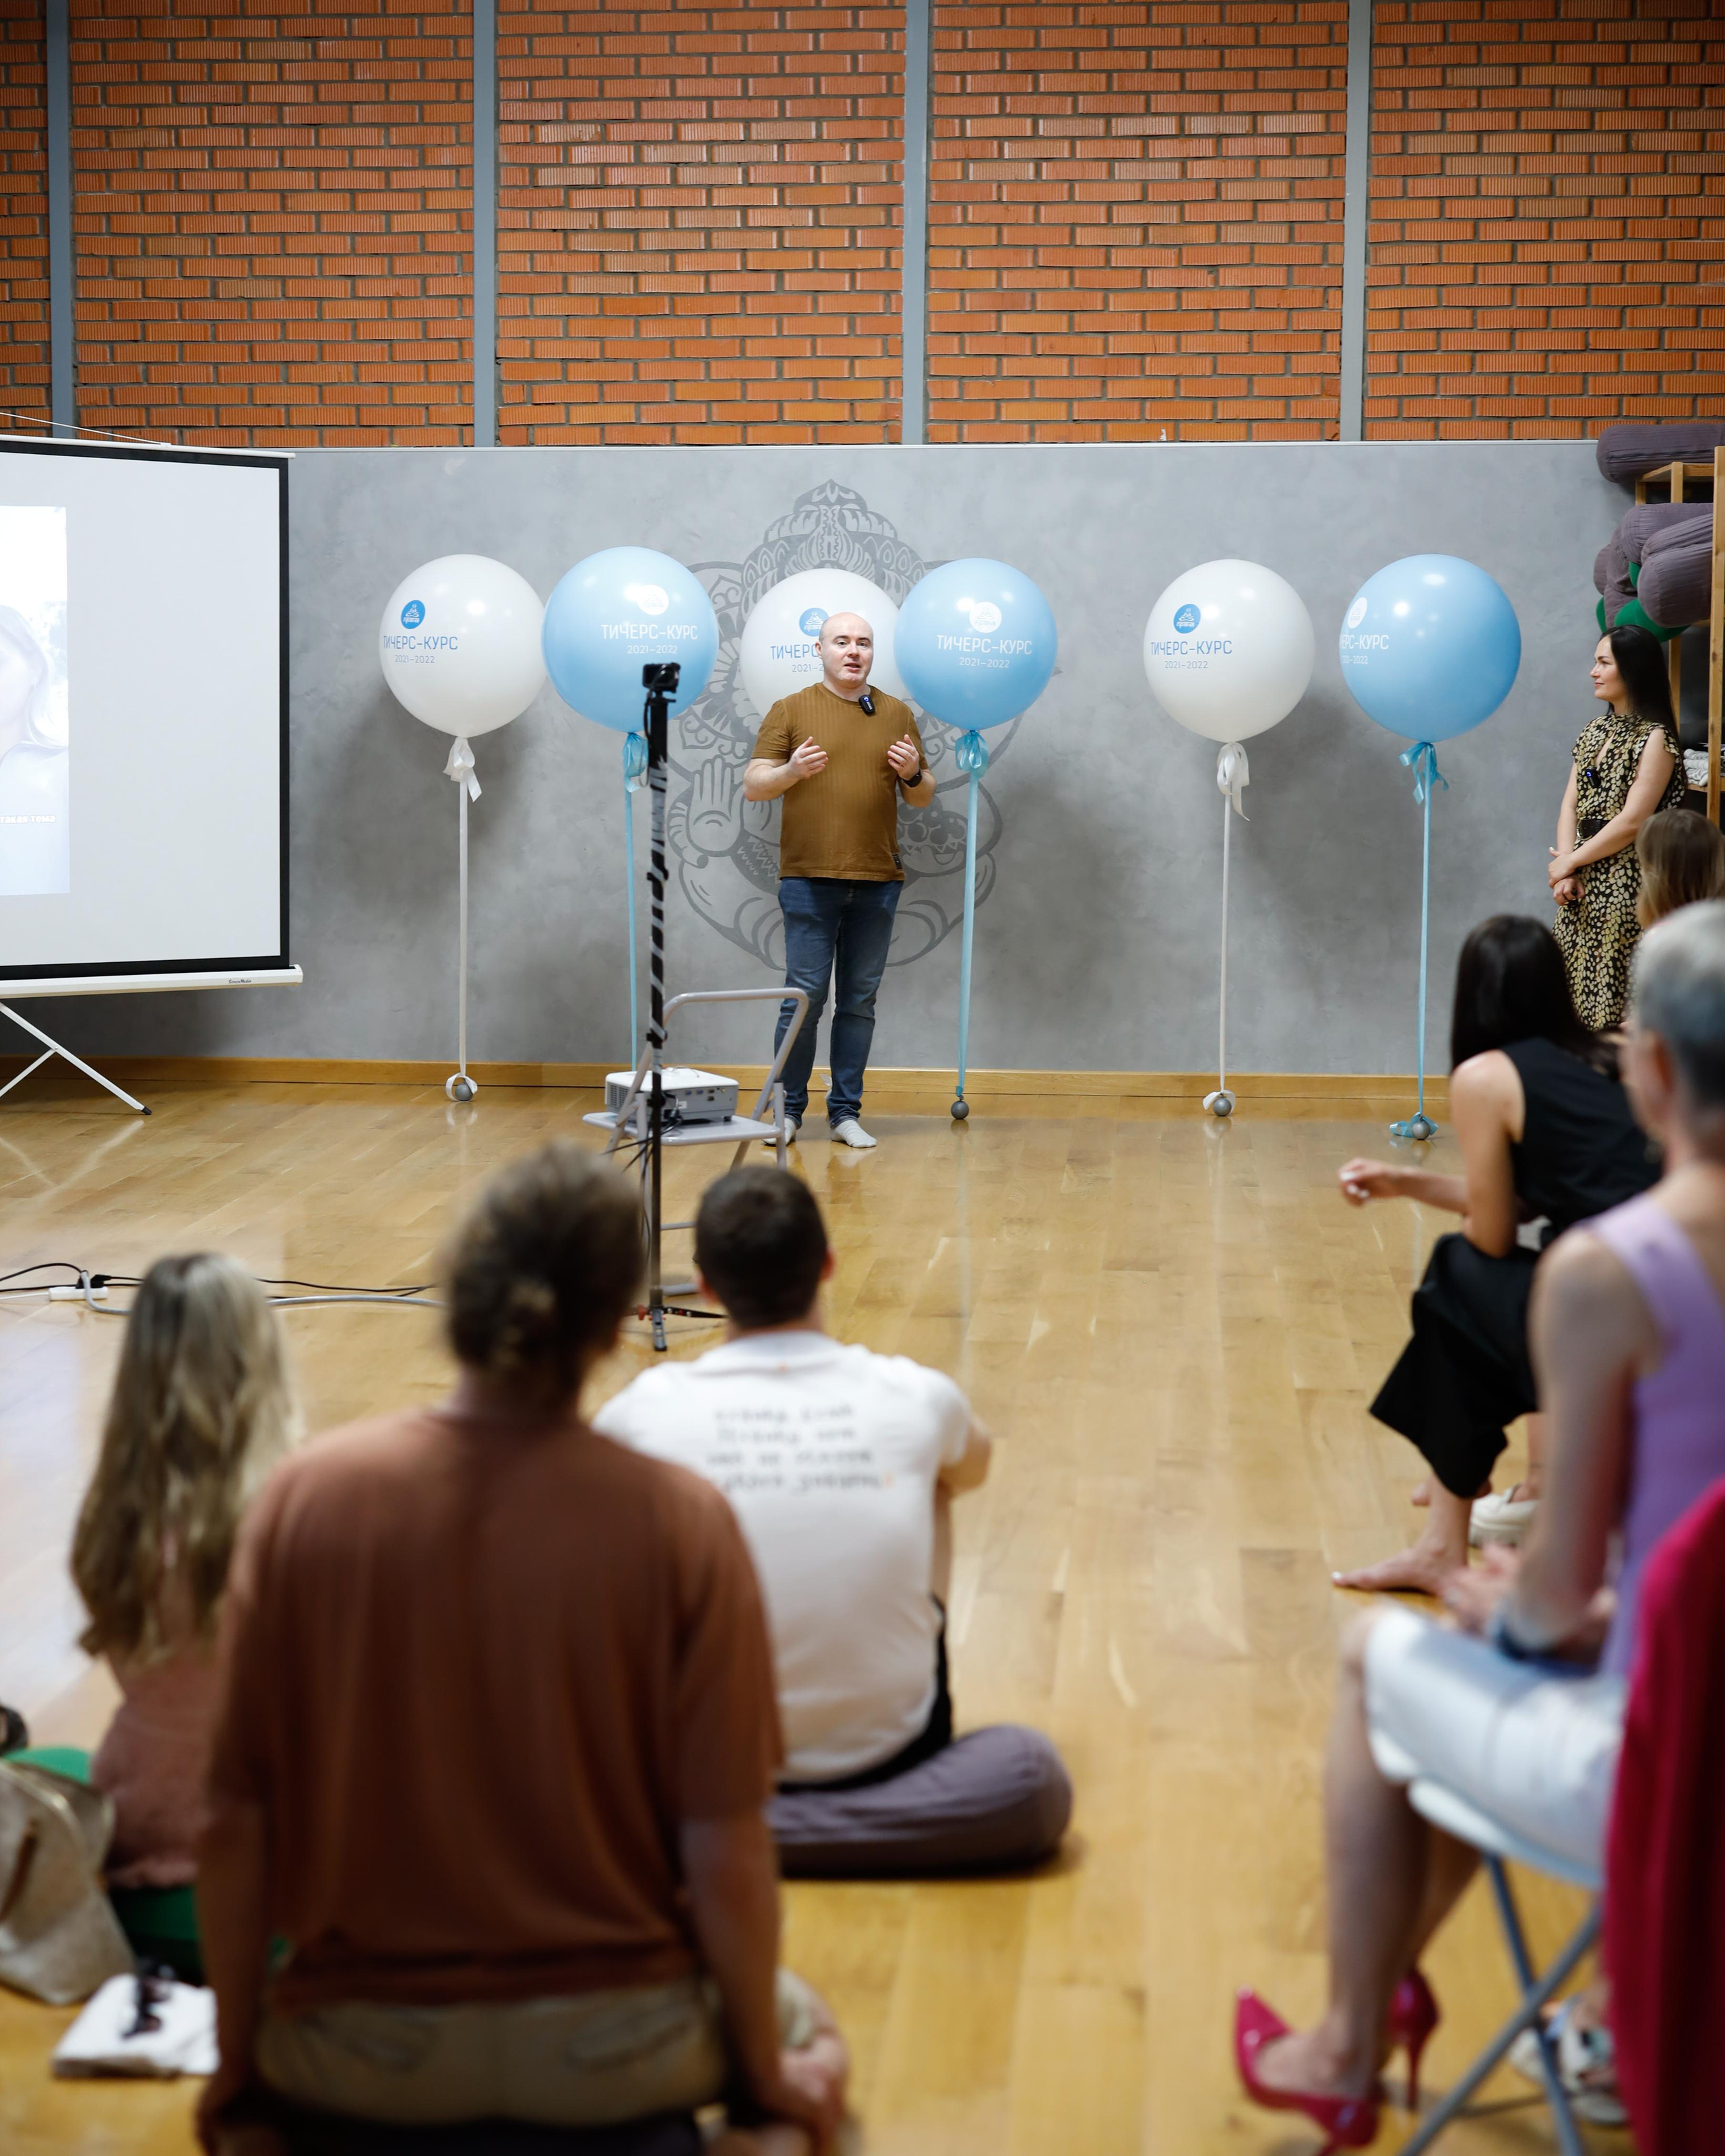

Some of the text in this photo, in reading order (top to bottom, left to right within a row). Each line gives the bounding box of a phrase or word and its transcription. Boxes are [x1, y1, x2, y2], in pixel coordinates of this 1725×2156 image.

[600, 624, 698, 640] ТИЧЕРС-КУРС
[383, 635, 458, 650] ТИЧЕРС-КУРС
[936, 635, 1032, 655] ТИЧЕРС-КУРС
[1150, 640, 1232, 656] ТИЧЕРС-КУРС
[627, 645, 678, 654] 2021-2022
[770, 644, 819, 660] ТИЧЕРС
[395, 654, 435, 664] 2021-2022
[959, 657, 1010, 668] 2021-2022
[1164, 660, 1208, 669] 2021-2022
[792, 664, 824, 672] 2021-2
